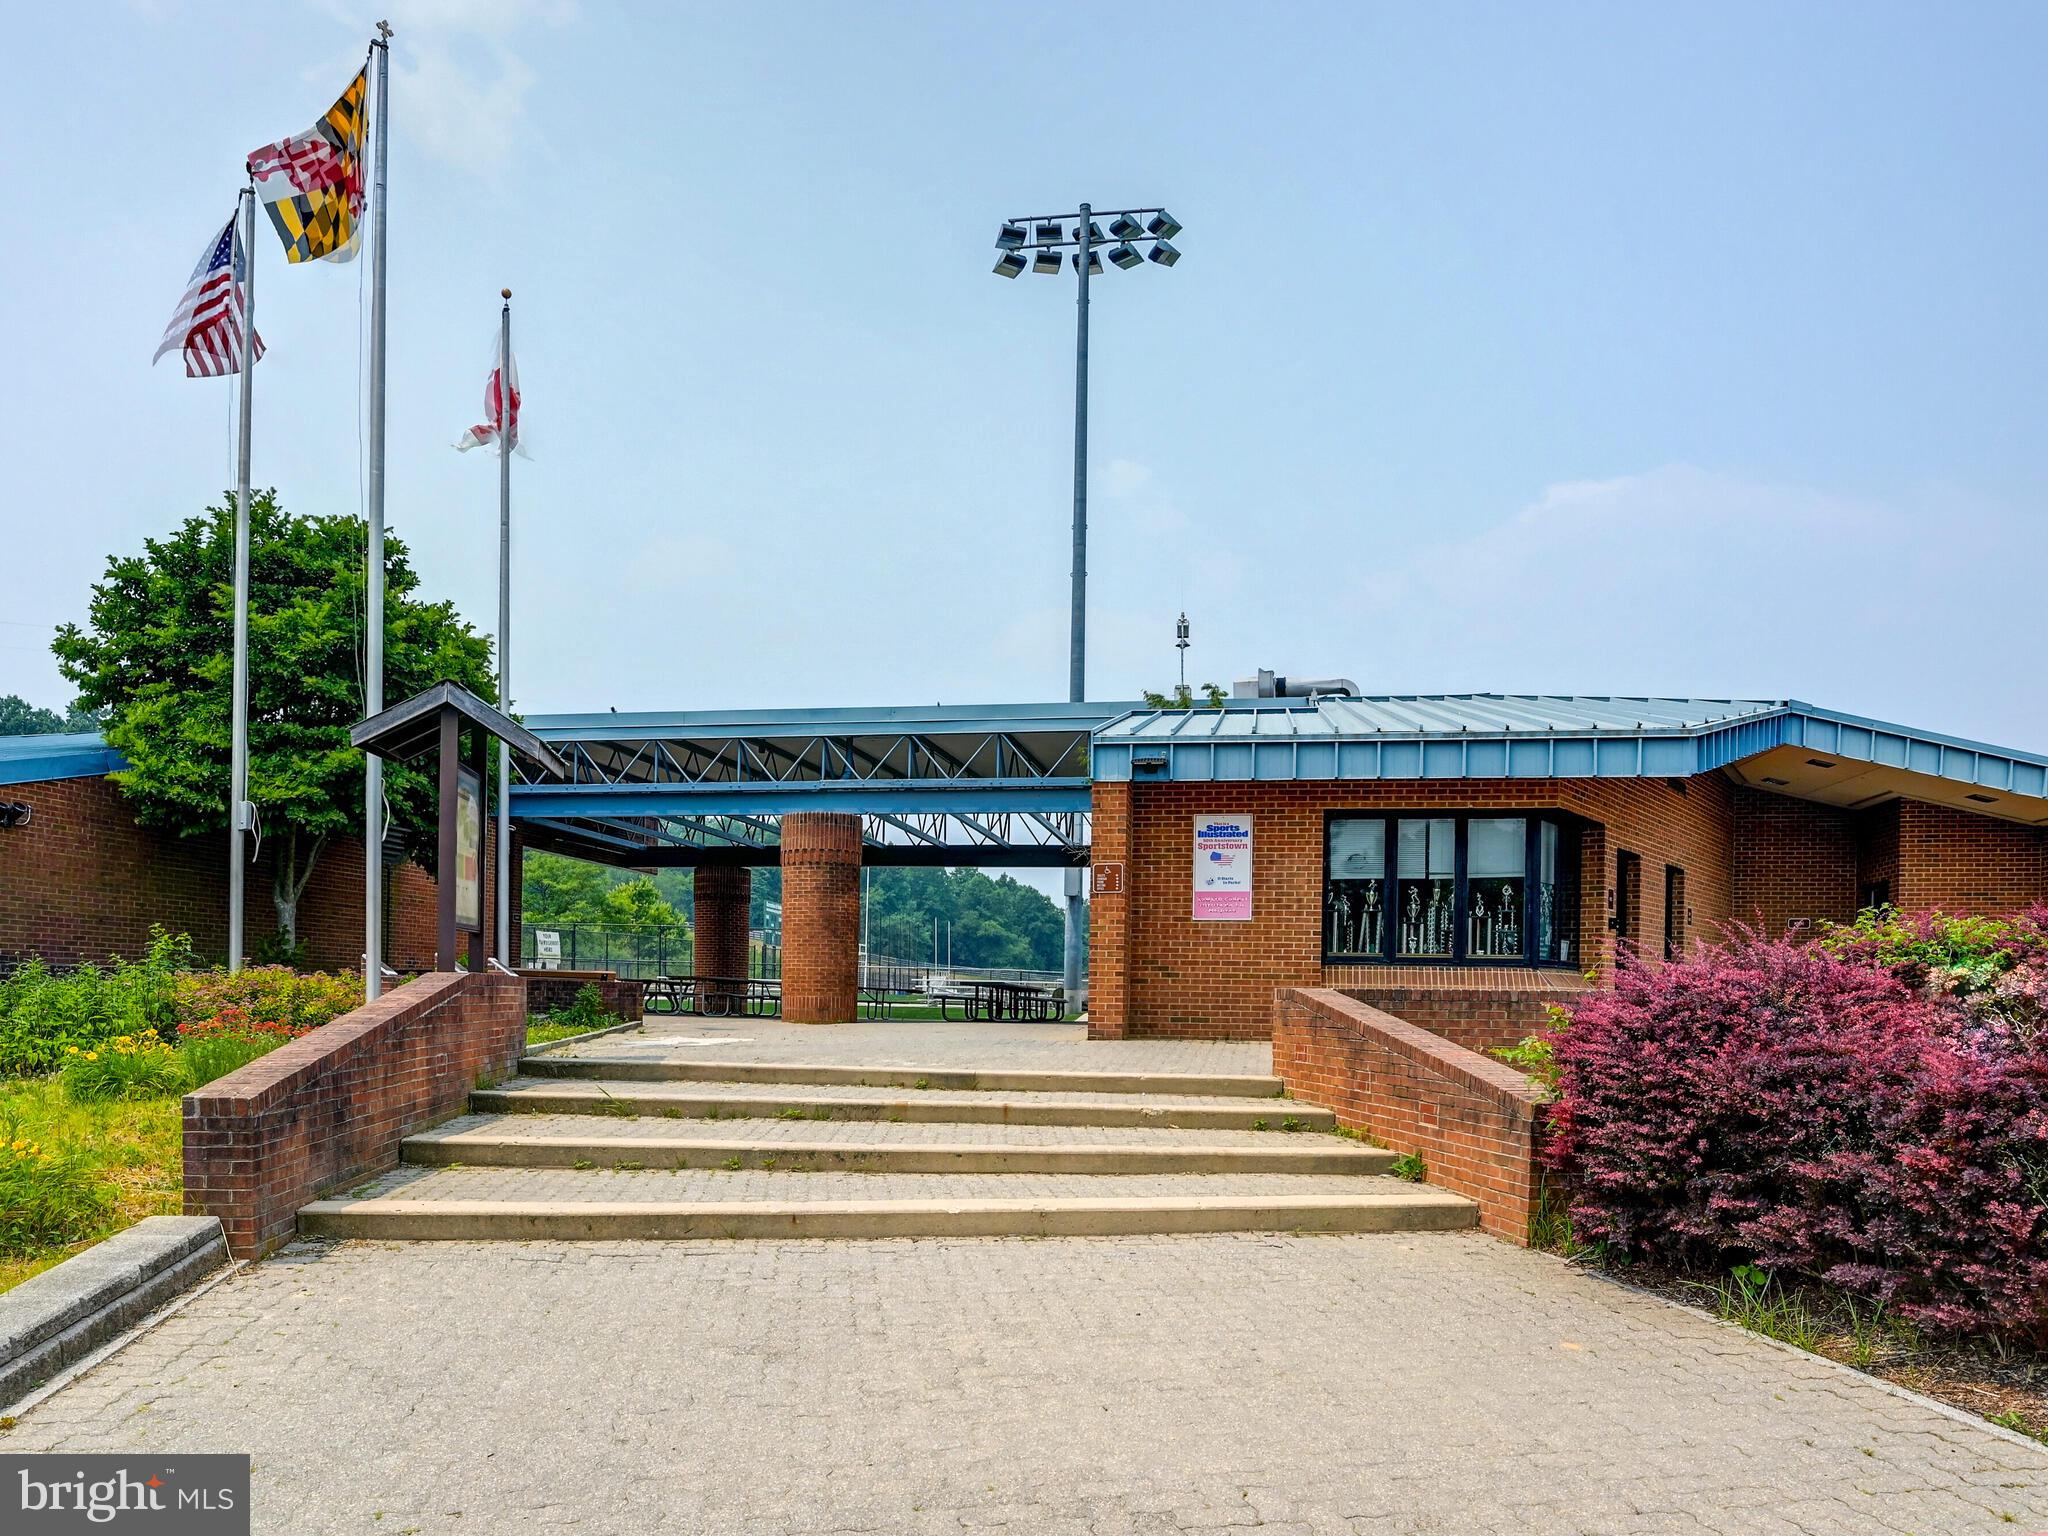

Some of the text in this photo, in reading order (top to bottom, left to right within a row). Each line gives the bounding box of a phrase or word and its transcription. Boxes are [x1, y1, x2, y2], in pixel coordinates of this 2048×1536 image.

[1206, 824, 1240, 832] Sports
[1198, 830, 1249, 838] Illustrated
[1198, 842, 1248, 850] Sportstown
